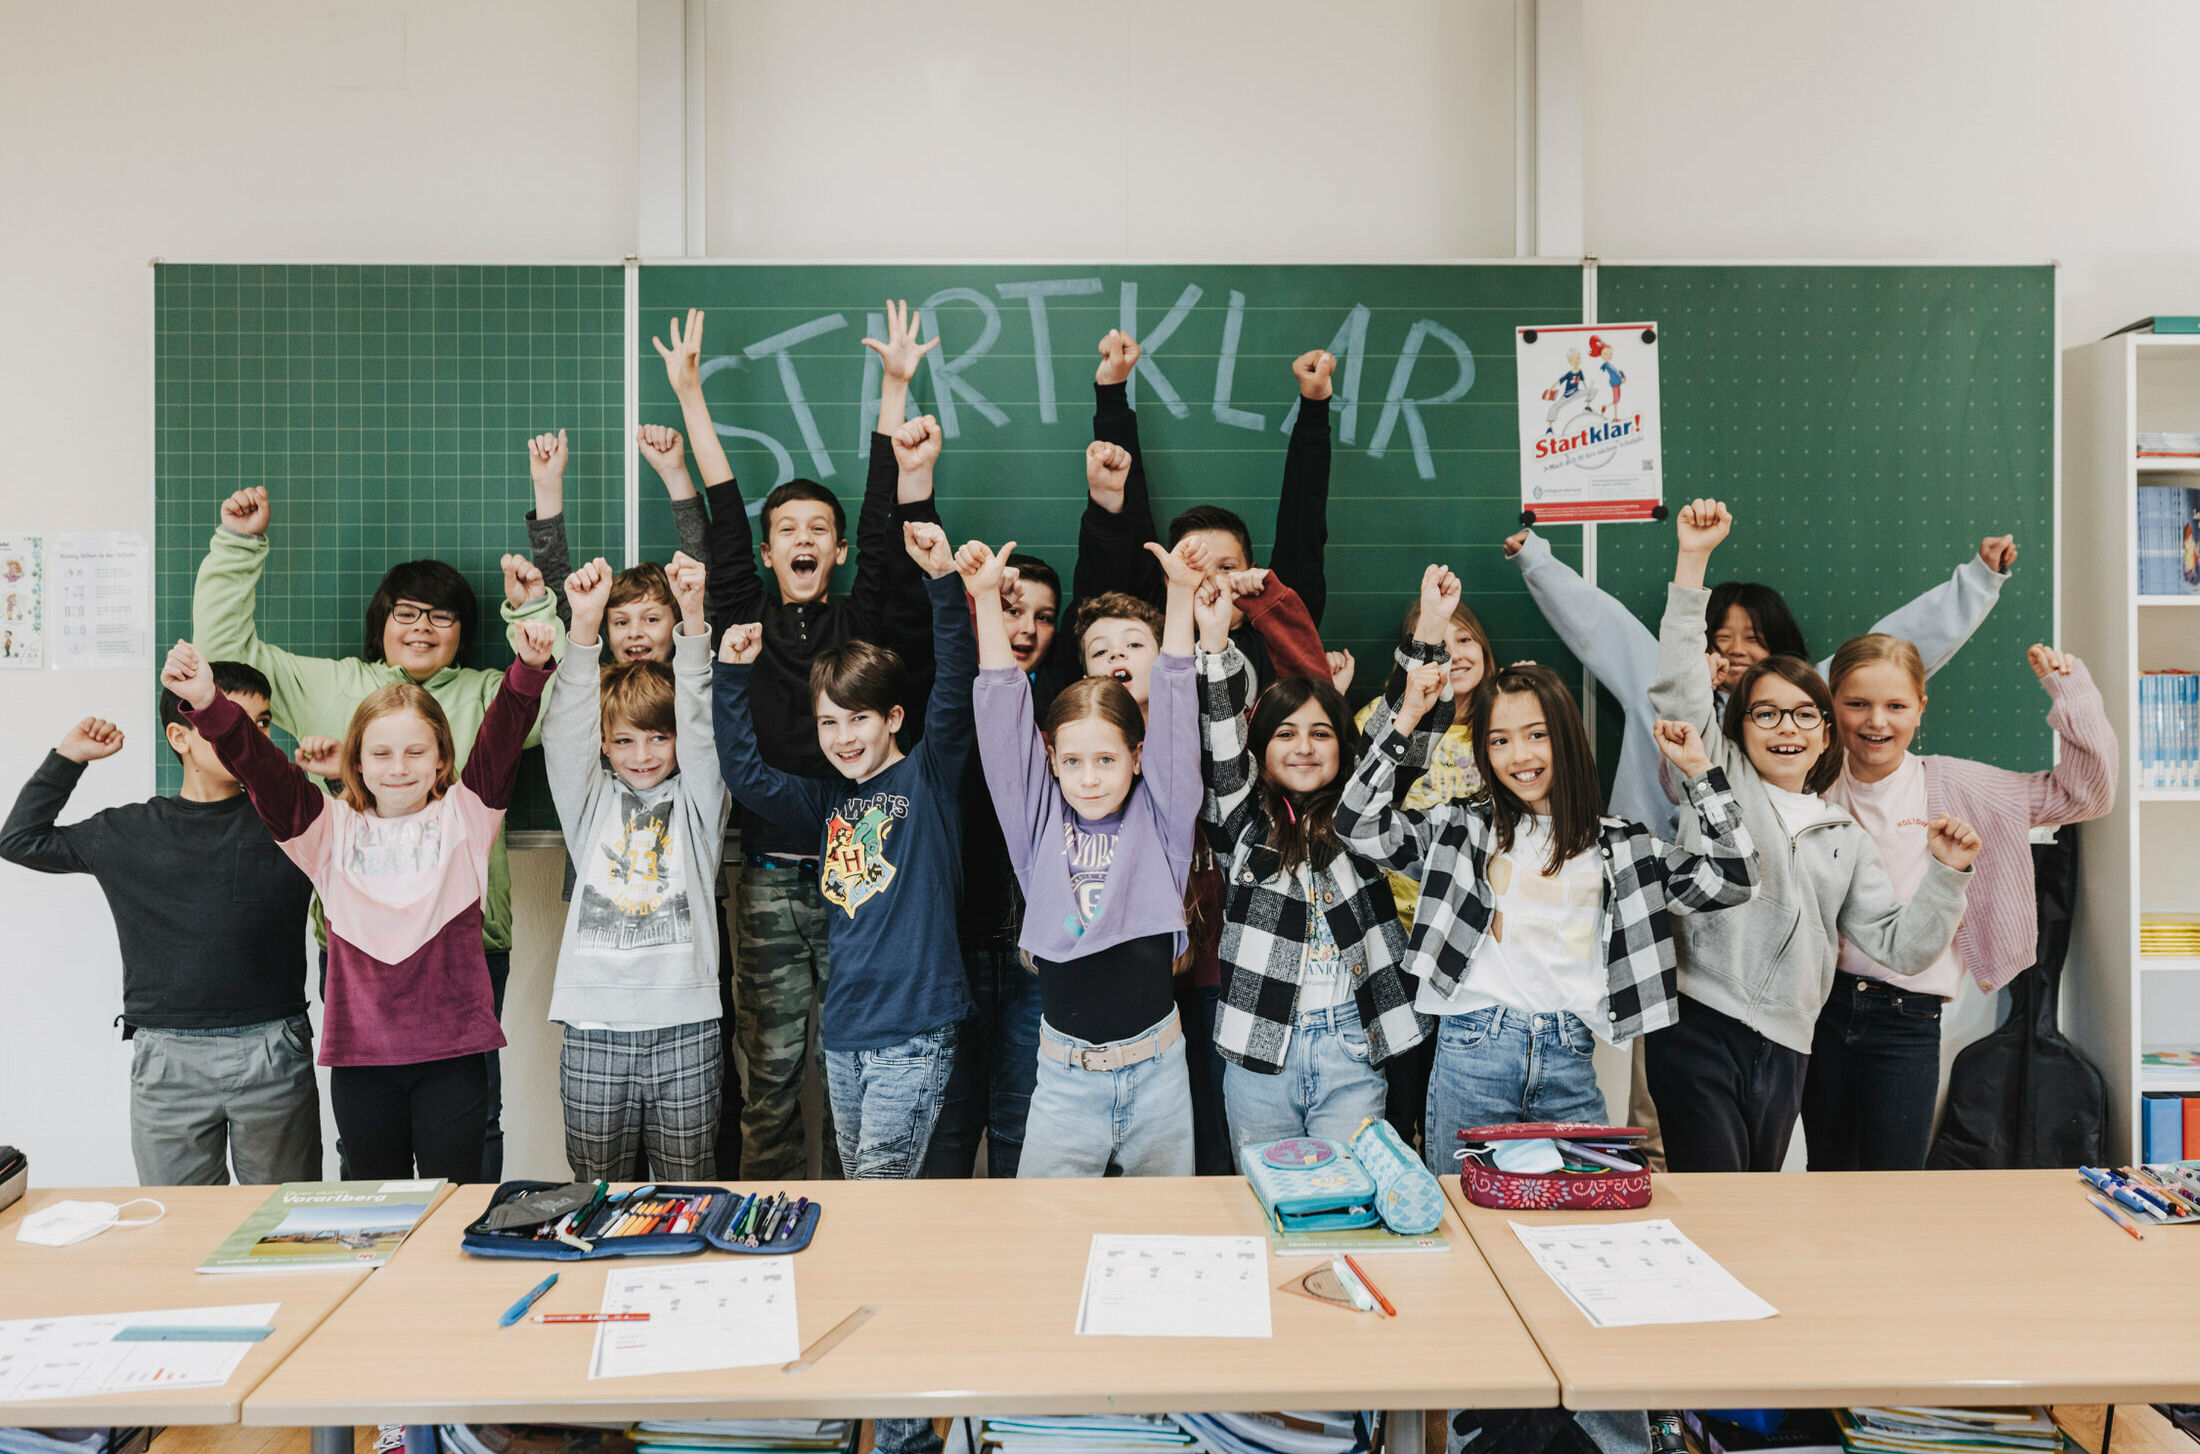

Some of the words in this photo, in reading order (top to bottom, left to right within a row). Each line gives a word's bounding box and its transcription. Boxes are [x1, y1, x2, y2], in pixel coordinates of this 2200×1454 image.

[1535, 413, 1641, 459] Startklar!
[626, 850, 658, 882] 73
[842, 849, 862, 874] H
[282, 1193, 389, 1204] Vorarlberg
